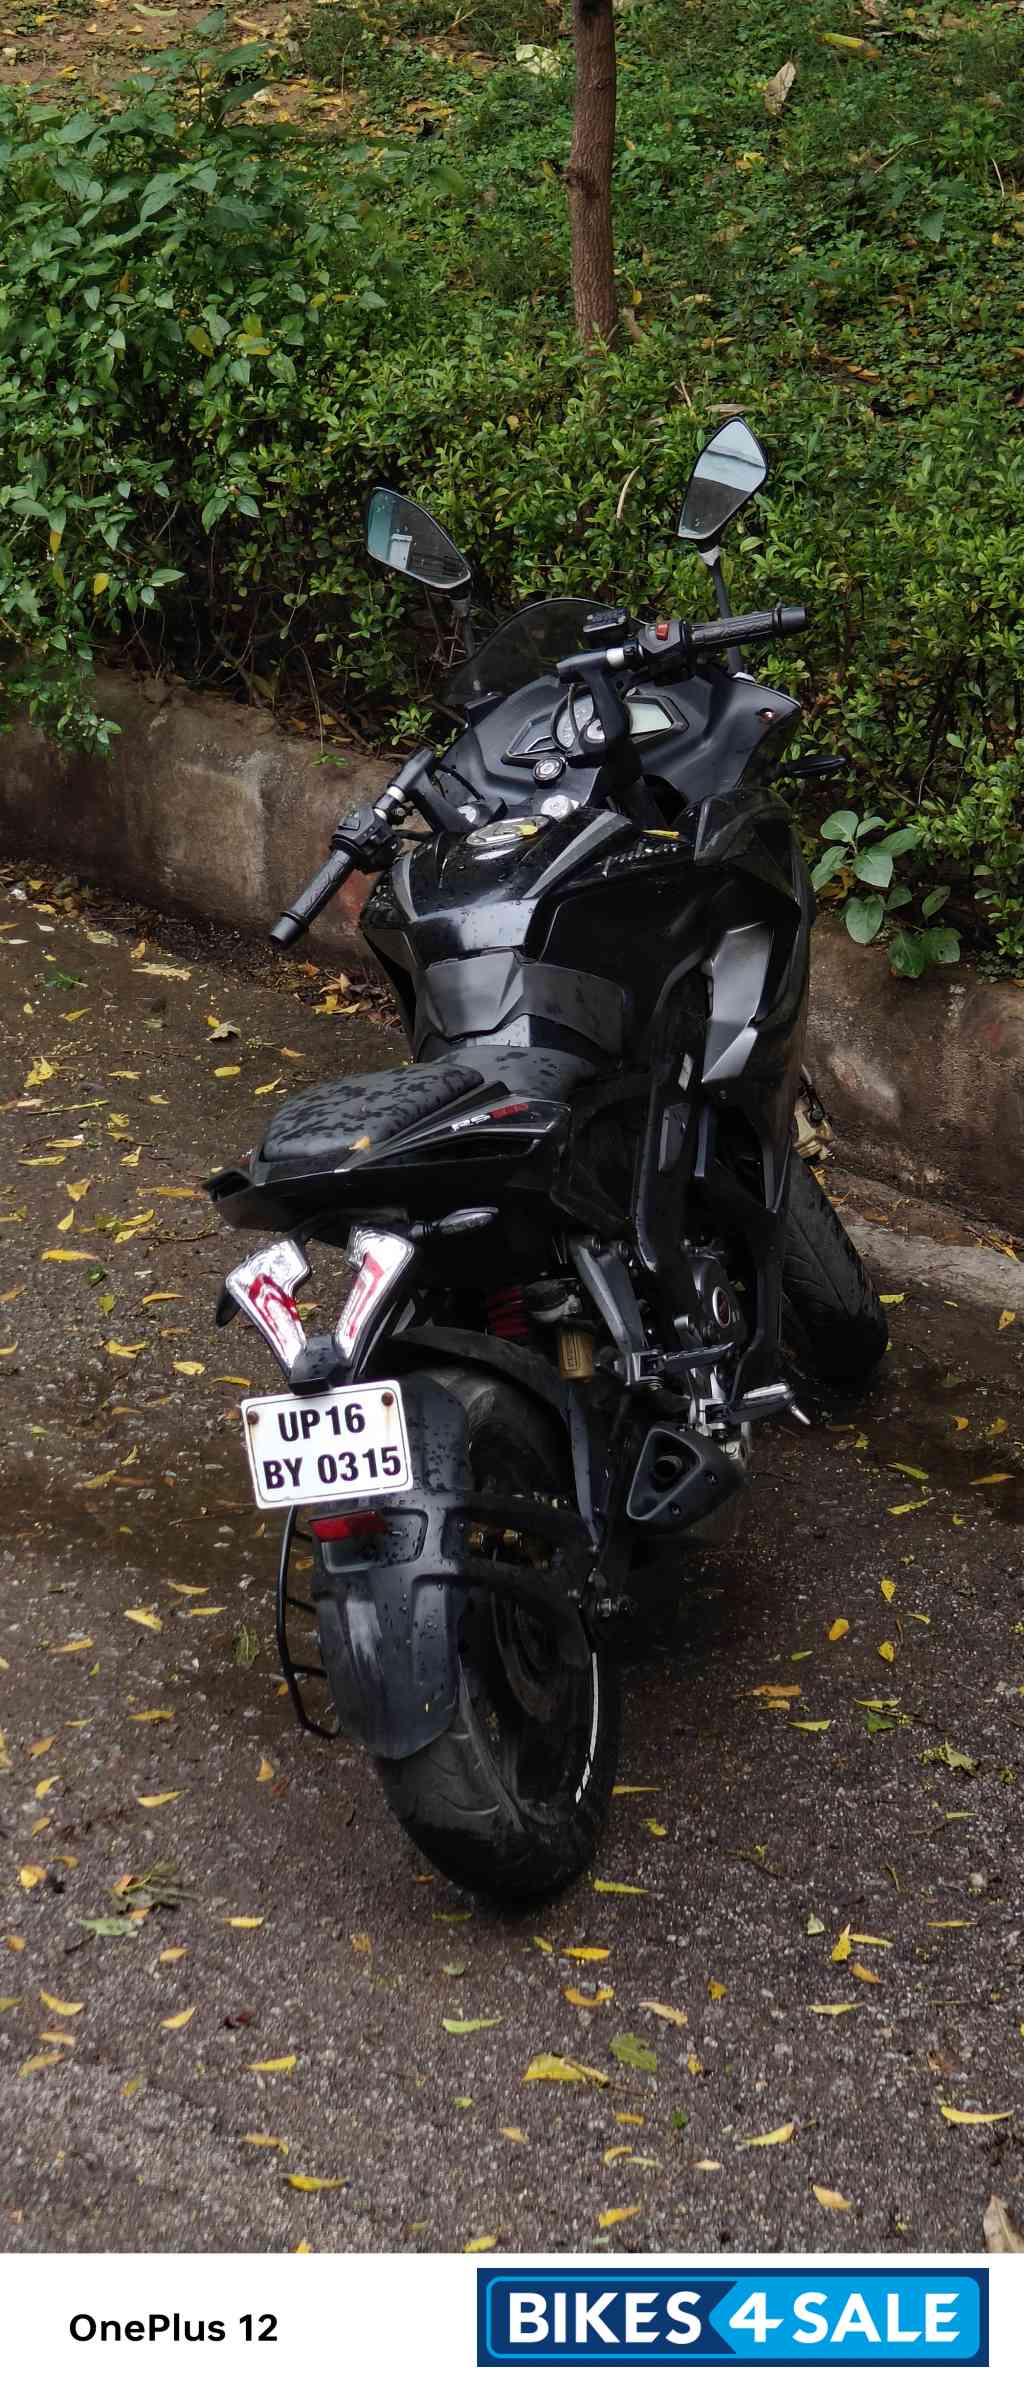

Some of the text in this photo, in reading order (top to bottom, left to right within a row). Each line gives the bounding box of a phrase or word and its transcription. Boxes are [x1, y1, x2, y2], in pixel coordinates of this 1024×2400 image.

[277, 1403, 366, 1442] UP16
[263, 1446, 402, 1490] BY 0315
